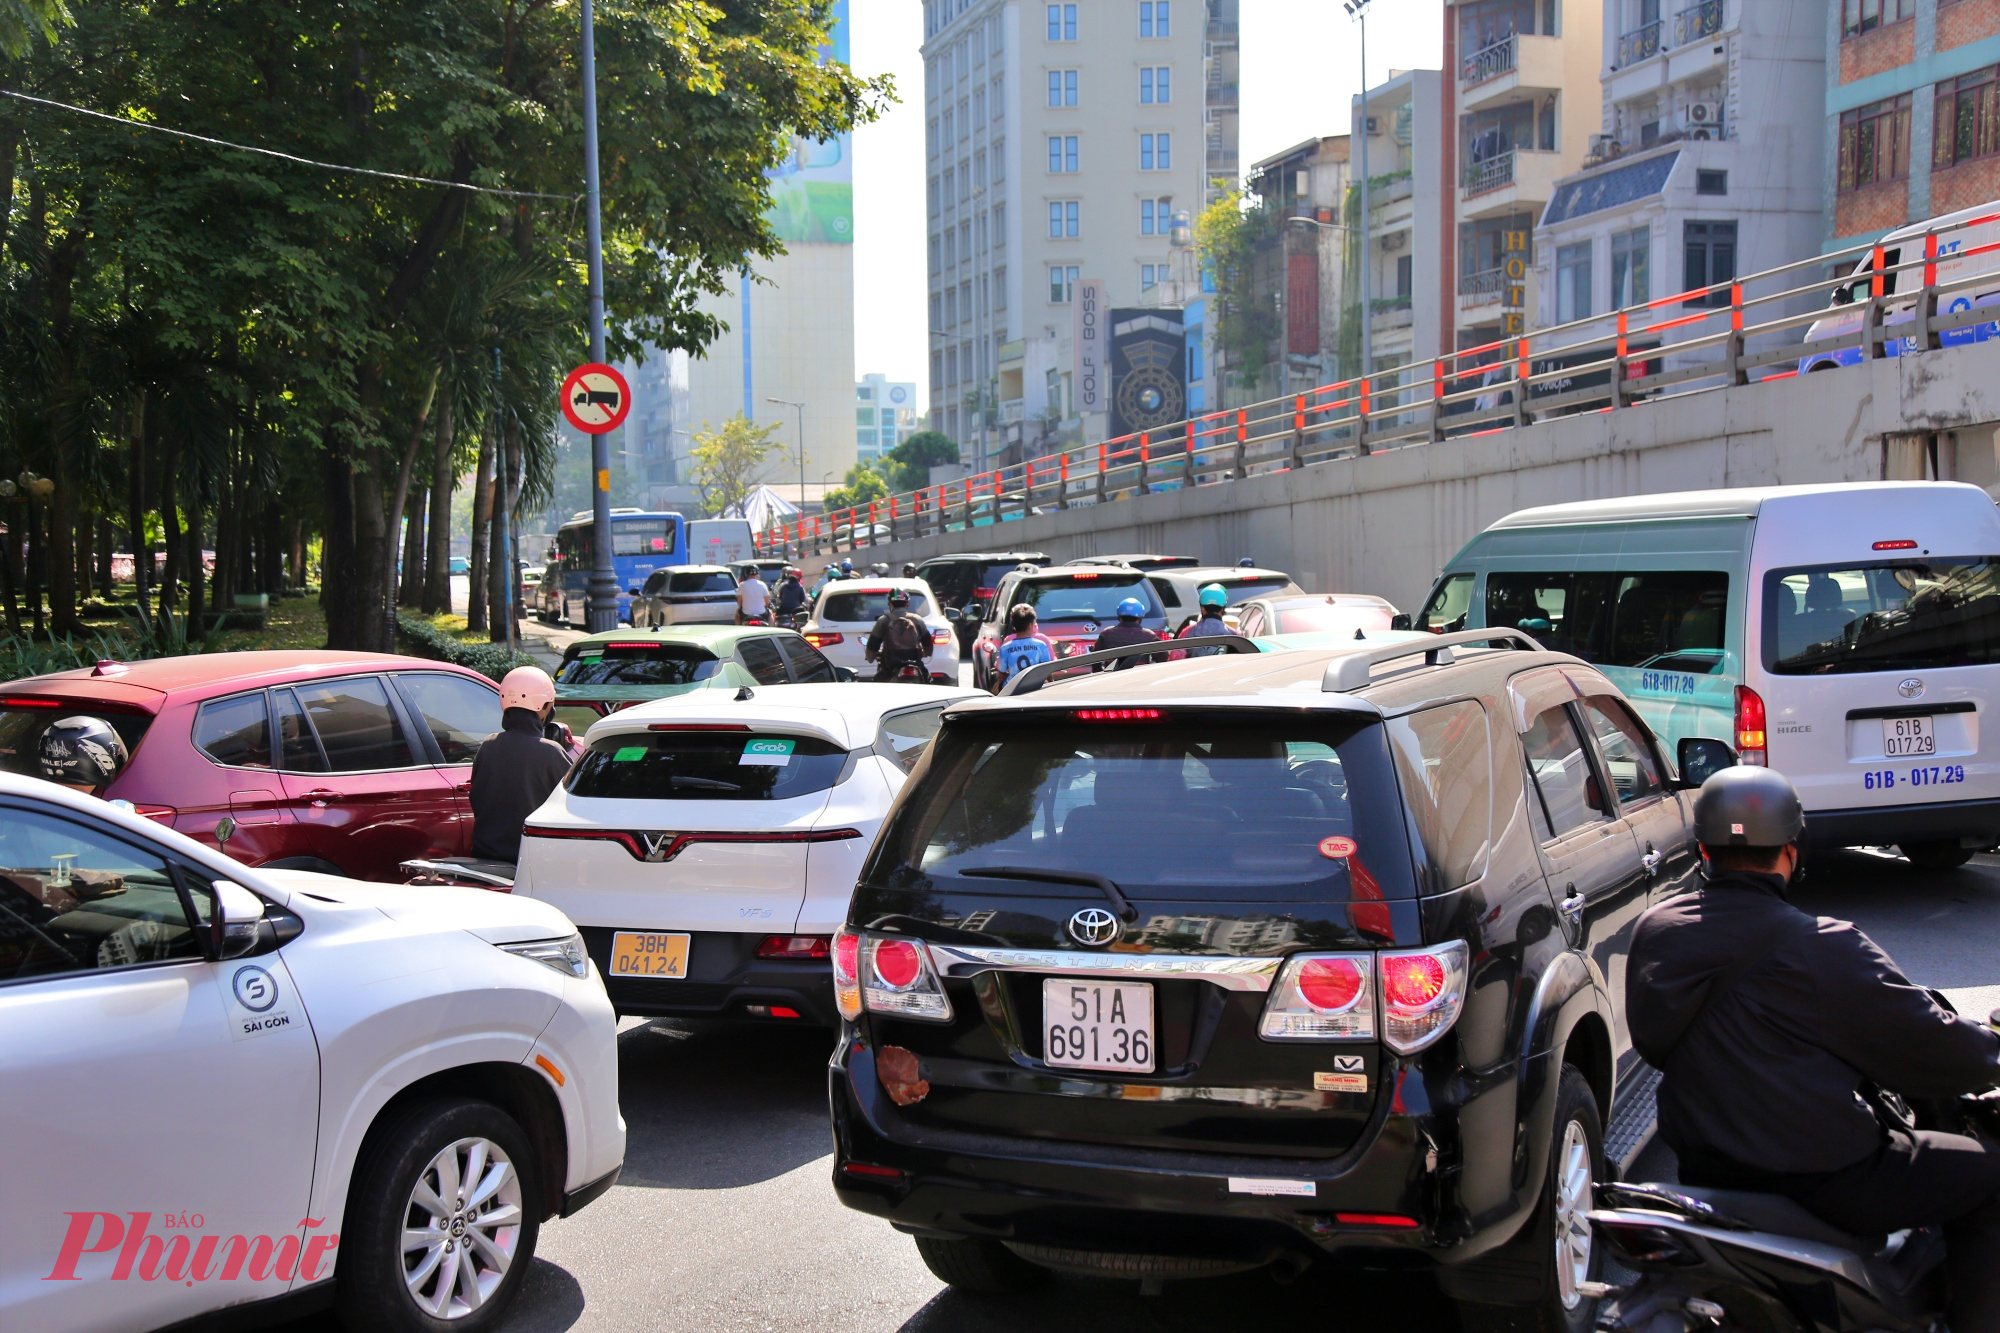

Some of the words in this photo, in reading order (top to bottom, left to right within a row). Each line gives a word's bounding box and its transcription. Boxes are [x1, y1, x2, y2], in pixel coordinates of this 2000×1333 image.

[1083, 286, 1095, 340] BOSS
[1083, 356, 1095, 405] GOLF
[1642, 672, 1695, 695] 61B-017.29
[1777, 725, 1813, 734] HIACE
[1896, 719, 1922, 736] 61B
[752, 742, 787, 753] Grab
[1887, 736, 1933, 754] 017.29
[1864, 770, 1895, 790] 61B
[1911, 765, 1965, 786] 017.29
[1326, 843, 1349, 852] TAS
[634, 935, 668, 954] 38H
[618, 955, 679, 975] 041.24
[985, 951, 1207, 971] FORTUNER
[1070, 986, 1127, 1025] 51A
[243, 1019, 263, 1034] SÀI
[264, 1015, 290, 1029] GÒN
[1049, 1024, 1150, 1065] 691.36
